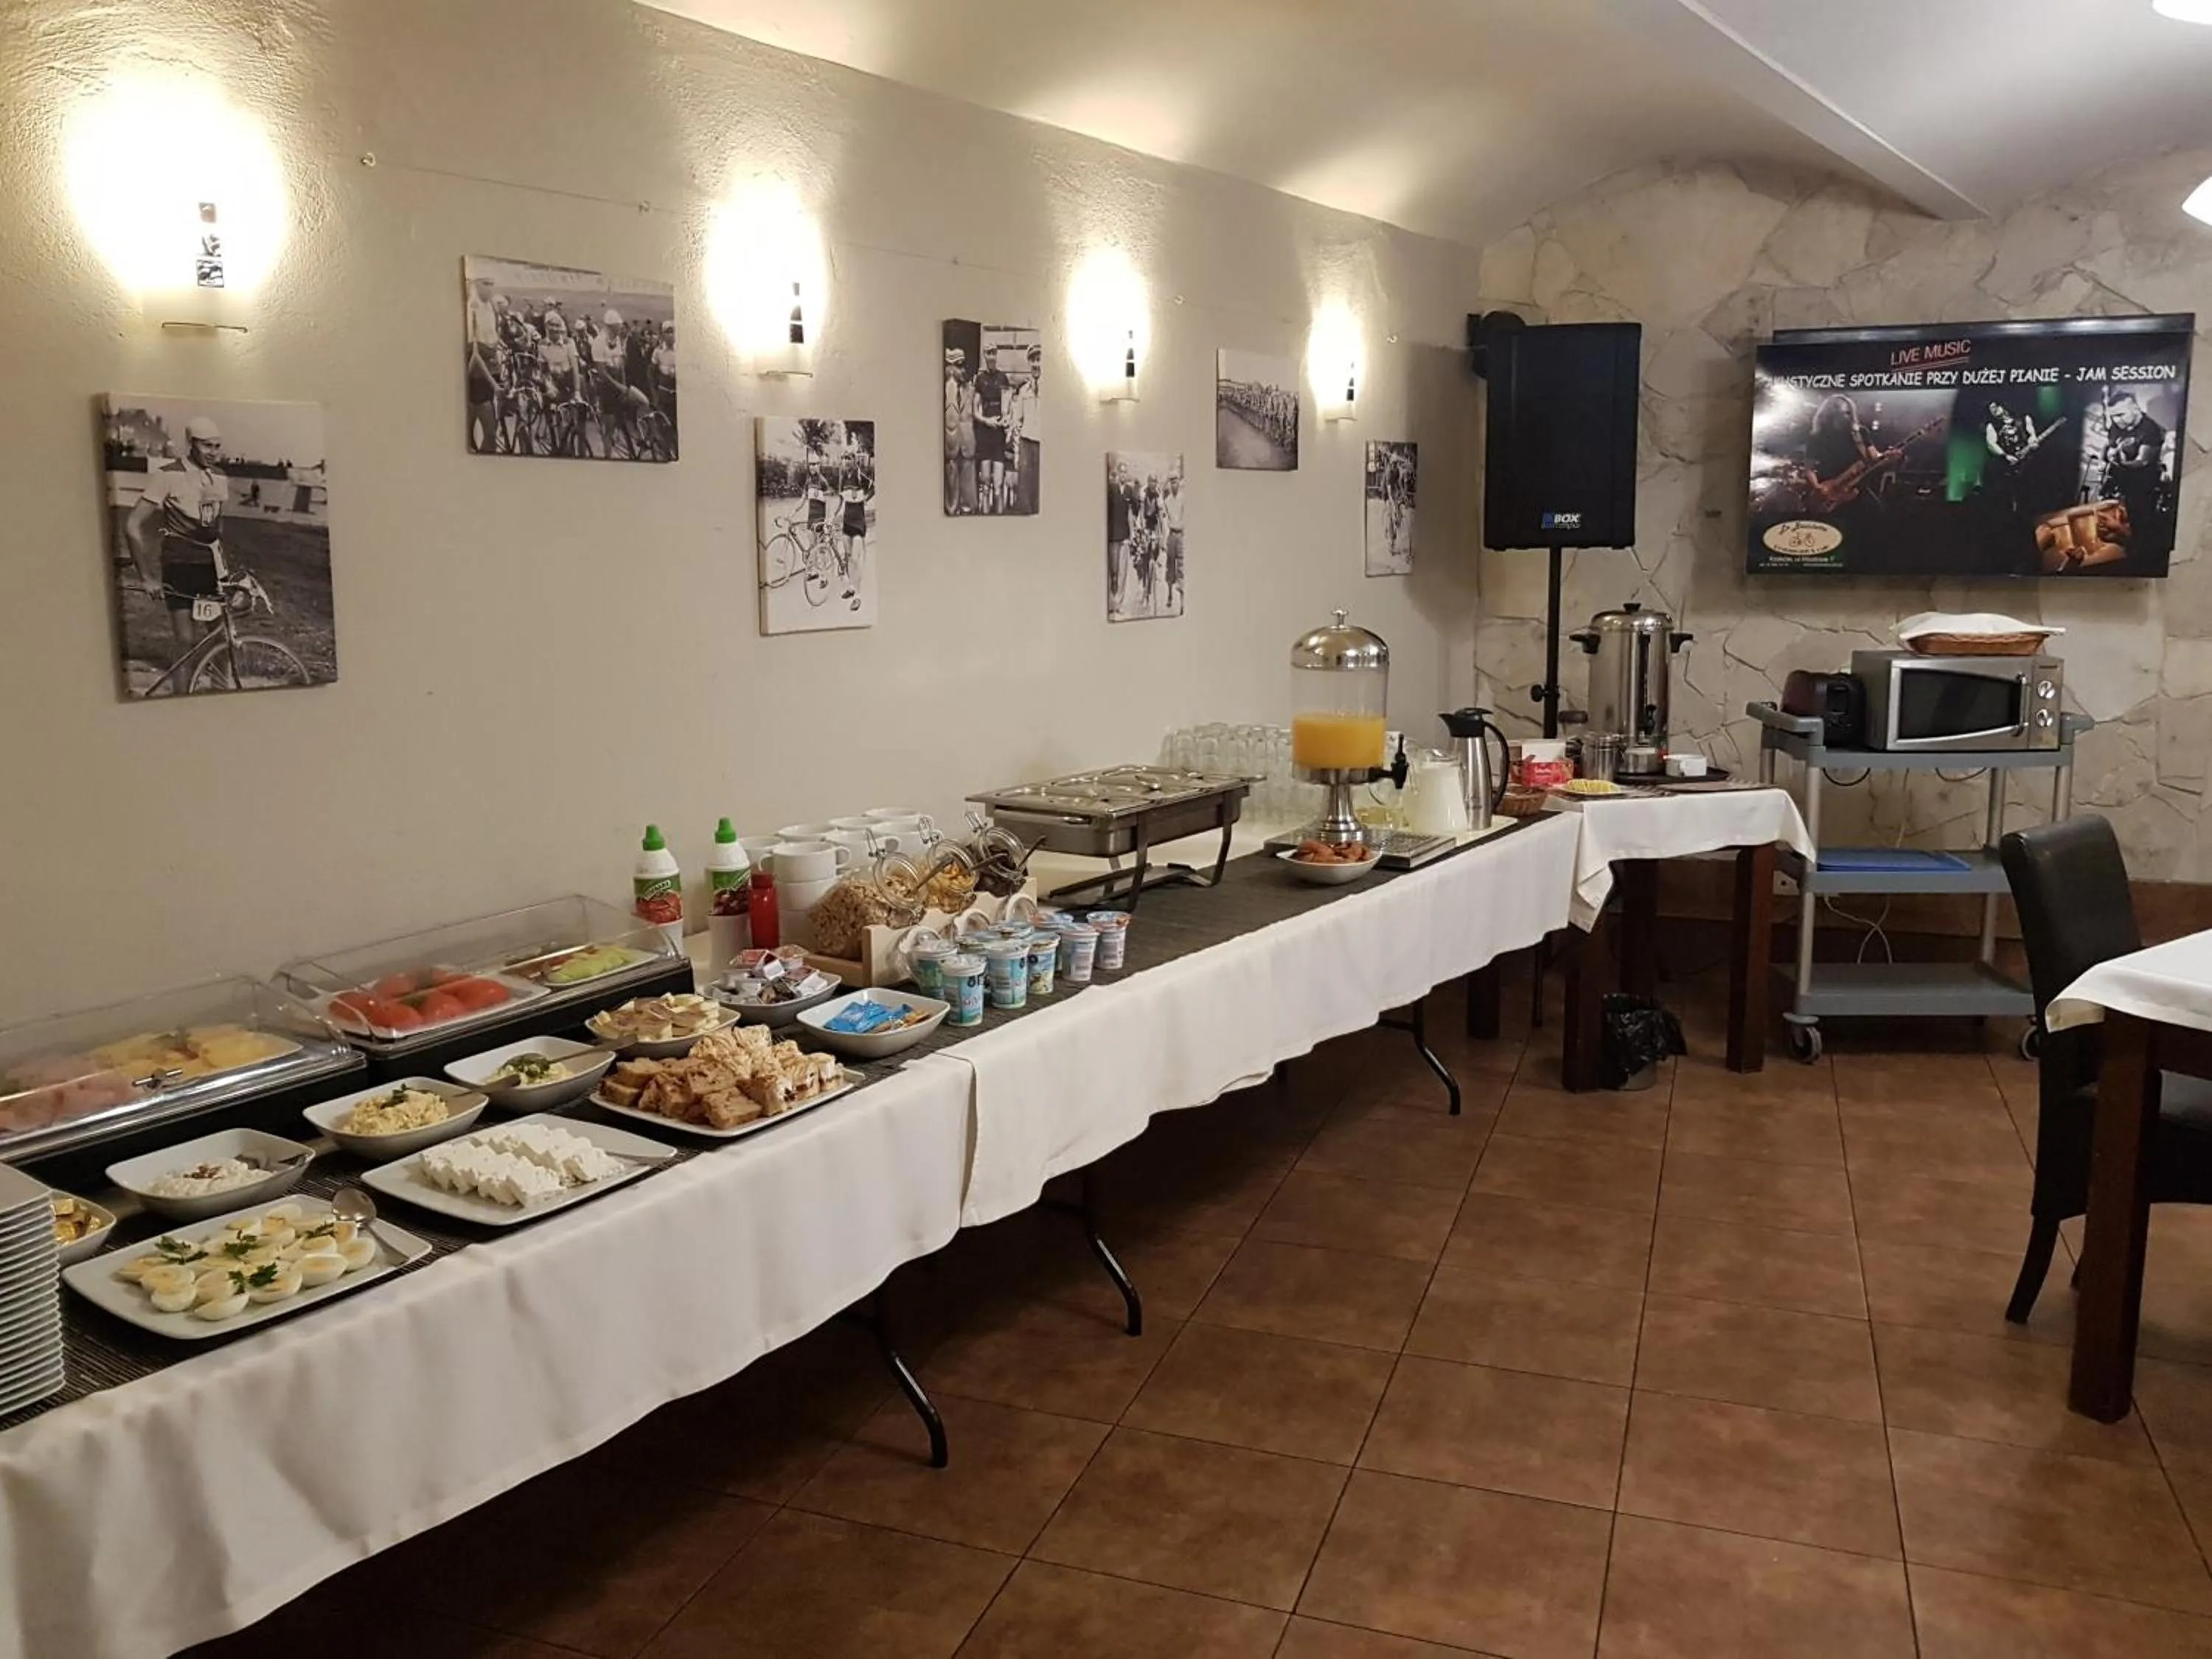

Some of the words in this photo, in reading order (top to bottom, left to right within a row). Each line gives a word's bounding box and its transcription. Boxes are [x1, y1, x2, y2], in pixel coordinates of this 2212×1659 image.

[1890, 347, 1921, 366] LIVE
[1924, 338, 1972, 360] MUSIC
[1848, 371, 1923, 387] SPOTKANIE
[1926, 371, 1958, 386] PRZY
[1962, 367, 2006, 385] DUŻEJ
[2009, 367, 2059, 383] PIANIE
[2076, 366, 2107, 381] JAM
[2111, 364, 2176, 380] SESSION
[197, 604, 212, 618] 16
